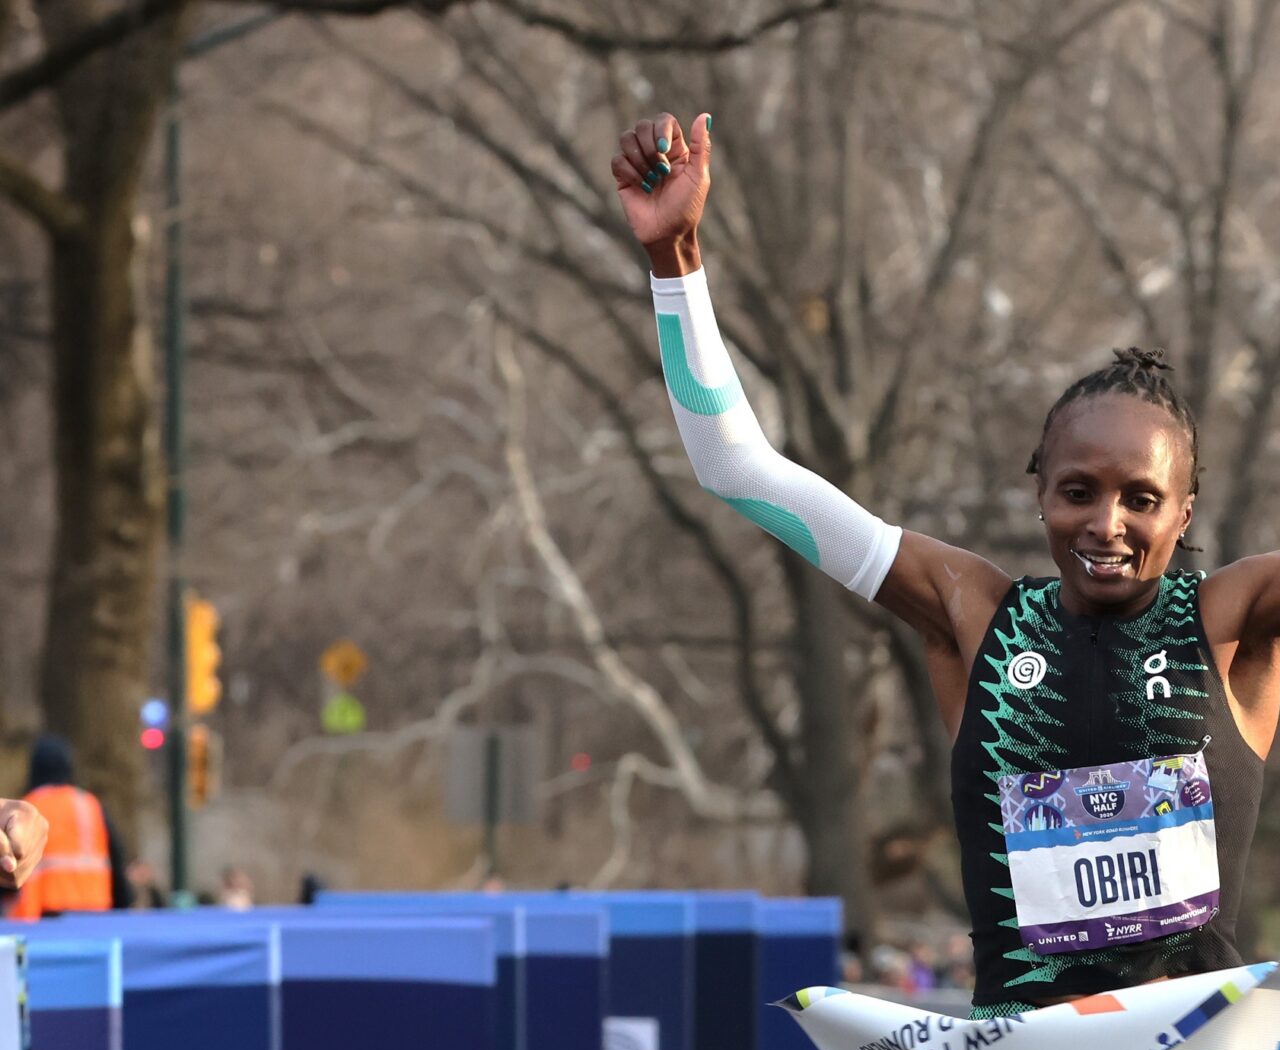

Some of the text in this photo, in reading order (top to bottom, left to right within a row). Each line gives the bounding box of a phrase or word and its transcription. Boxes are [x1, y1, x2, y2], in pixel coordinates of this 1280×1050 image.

[1089, 792, 1118, 805] NYC
[1093, 802, 1117, 812] HALF
[1073, 848, 1162, 908] OBIRI
[1115, 923, 1142, 936] NYRR
[1038, 934, 1077, 945] UNITED
